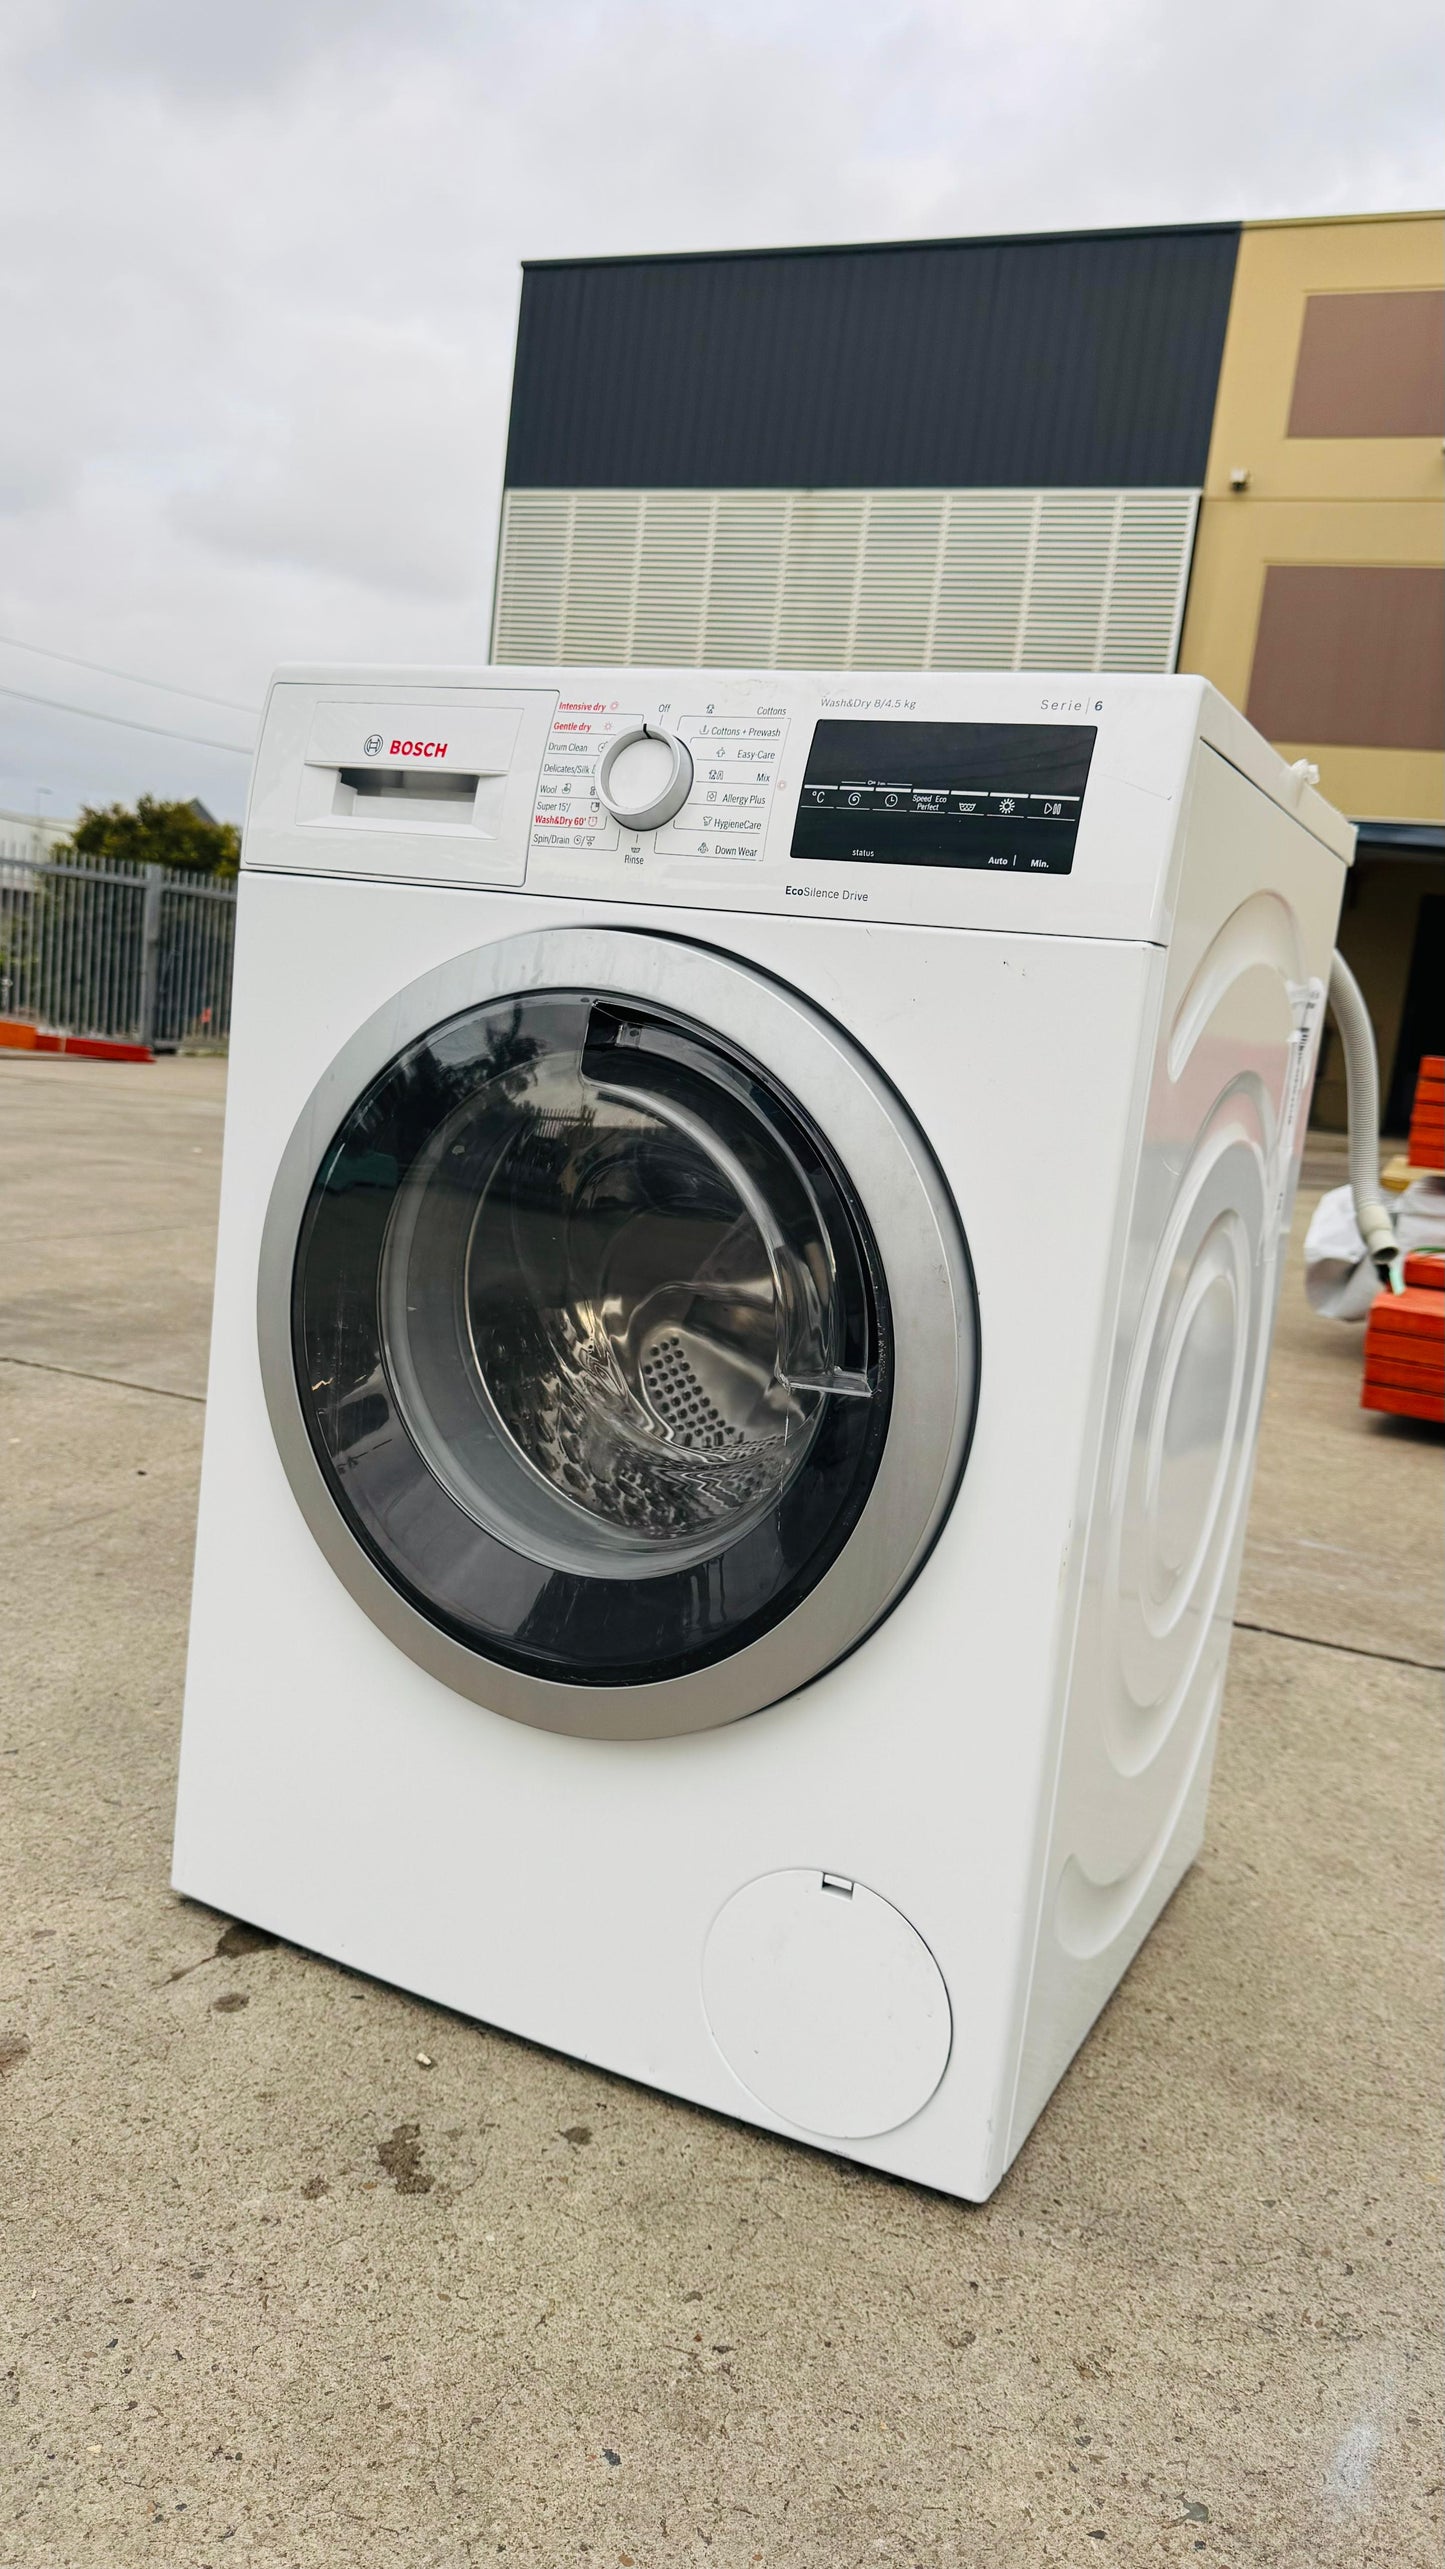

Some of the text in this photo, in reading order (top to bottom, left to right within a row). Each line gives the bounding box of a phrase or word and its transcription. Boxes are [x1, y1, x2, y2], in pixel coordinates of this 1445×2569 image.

[559, 702, 607, 712] Intensive dry
[658, 704, 671, 713] Off
[821, 698, 917, 710] Wash&Dry 8/4.5 kg
[1041, 699, 1103, 711] Serie 6
[756, 706, 787, 715] Cottons
[553, 722, 591, 732] Gentle dry
[711, 726, 740, 736] Cottons
[748, 727, 781, 737] Prewash
[389, 739, 448, 758] BOSCH
[548, 742, 588, 752] Drum Clean
[544, 763, 590, 774] Delicates/Silk
[756, 773, 770, 782] Mix
[540, 785, 557, 794] Wool
[722, 793, 766, 805] Allergy Plus
[912, 794, 947, 803] Speed Eco
[536, 801, 557, 812] Super
[916, 802, 939, 811] Perfect
[535, 815, 573, 827] Wash&Dry
[714, 818, 762, 830] HygieneCare
[533, 833, 570, 845] Spin/Drain
[715, 845, 758, 857] Down Wear
[624, 855, 644, 865] Rinse
[988, 856, 1008, 866] Auto
[1031, 858, 1050, 869] Min.
[785, 885, 869, 902] EcoSilence Drive
